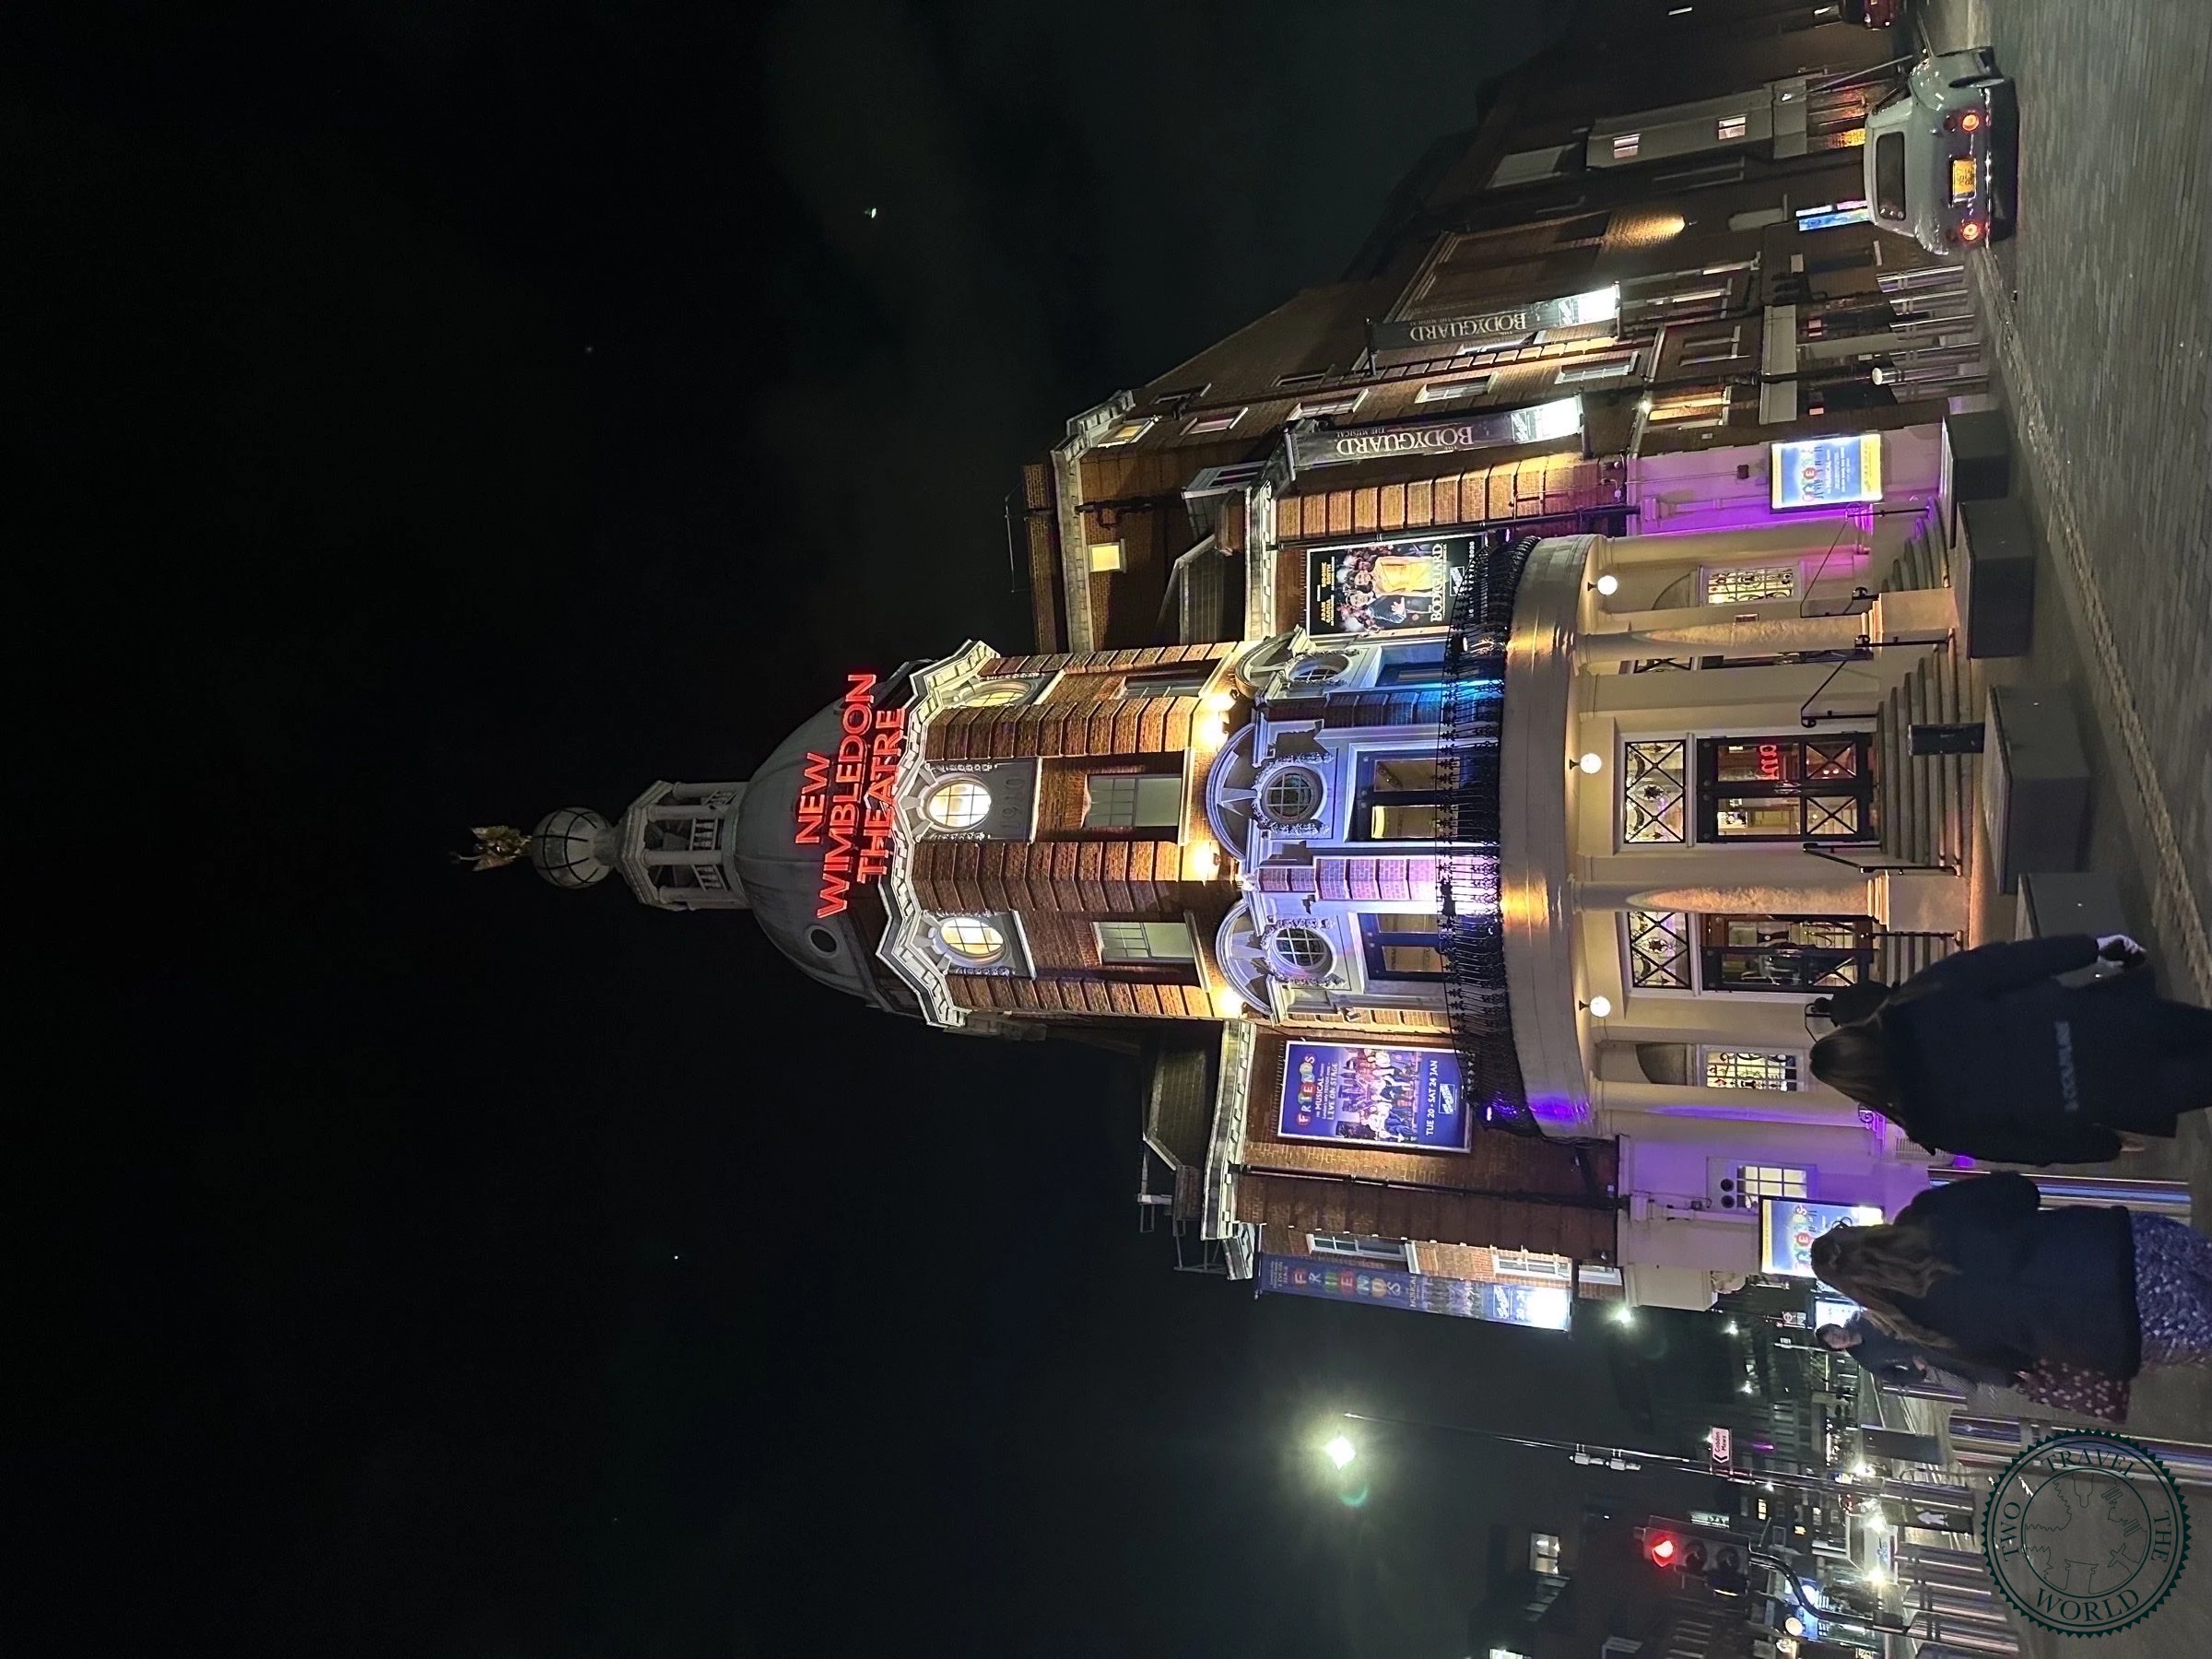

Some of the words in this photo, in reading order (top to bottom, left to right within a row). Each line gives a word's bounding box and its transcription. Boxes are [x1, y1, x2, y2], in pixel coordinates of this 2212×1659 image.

[1410, 313, 1527, 341] BODYGUARD
[1336, 426, 1474, 455] BODYGUARD
[1430, 544, 1443, 622] BODYGUARD
[794, 752, 830, 843] NEW
[817, 674, 877, 919] WIMBLEDON
[857, 708, 904, 884] THEATRE
[1001, 776, 1025, 829] 1910
[1430, 1061, 1438, 1076] JAN
[1430, 1077, 1437, 1087] 24
[1298, 1056, 1314, 1123] FRIENDS
[1315, 1077, 1324, 1110] MUSICAL
[1330, 1088, 1335, 1099] ON
[1428, 1088, 1436, 1102] SAT
[1426, 1120, 1434, 1135] TUE
[1427, 1109, 1435, 1118] 20
